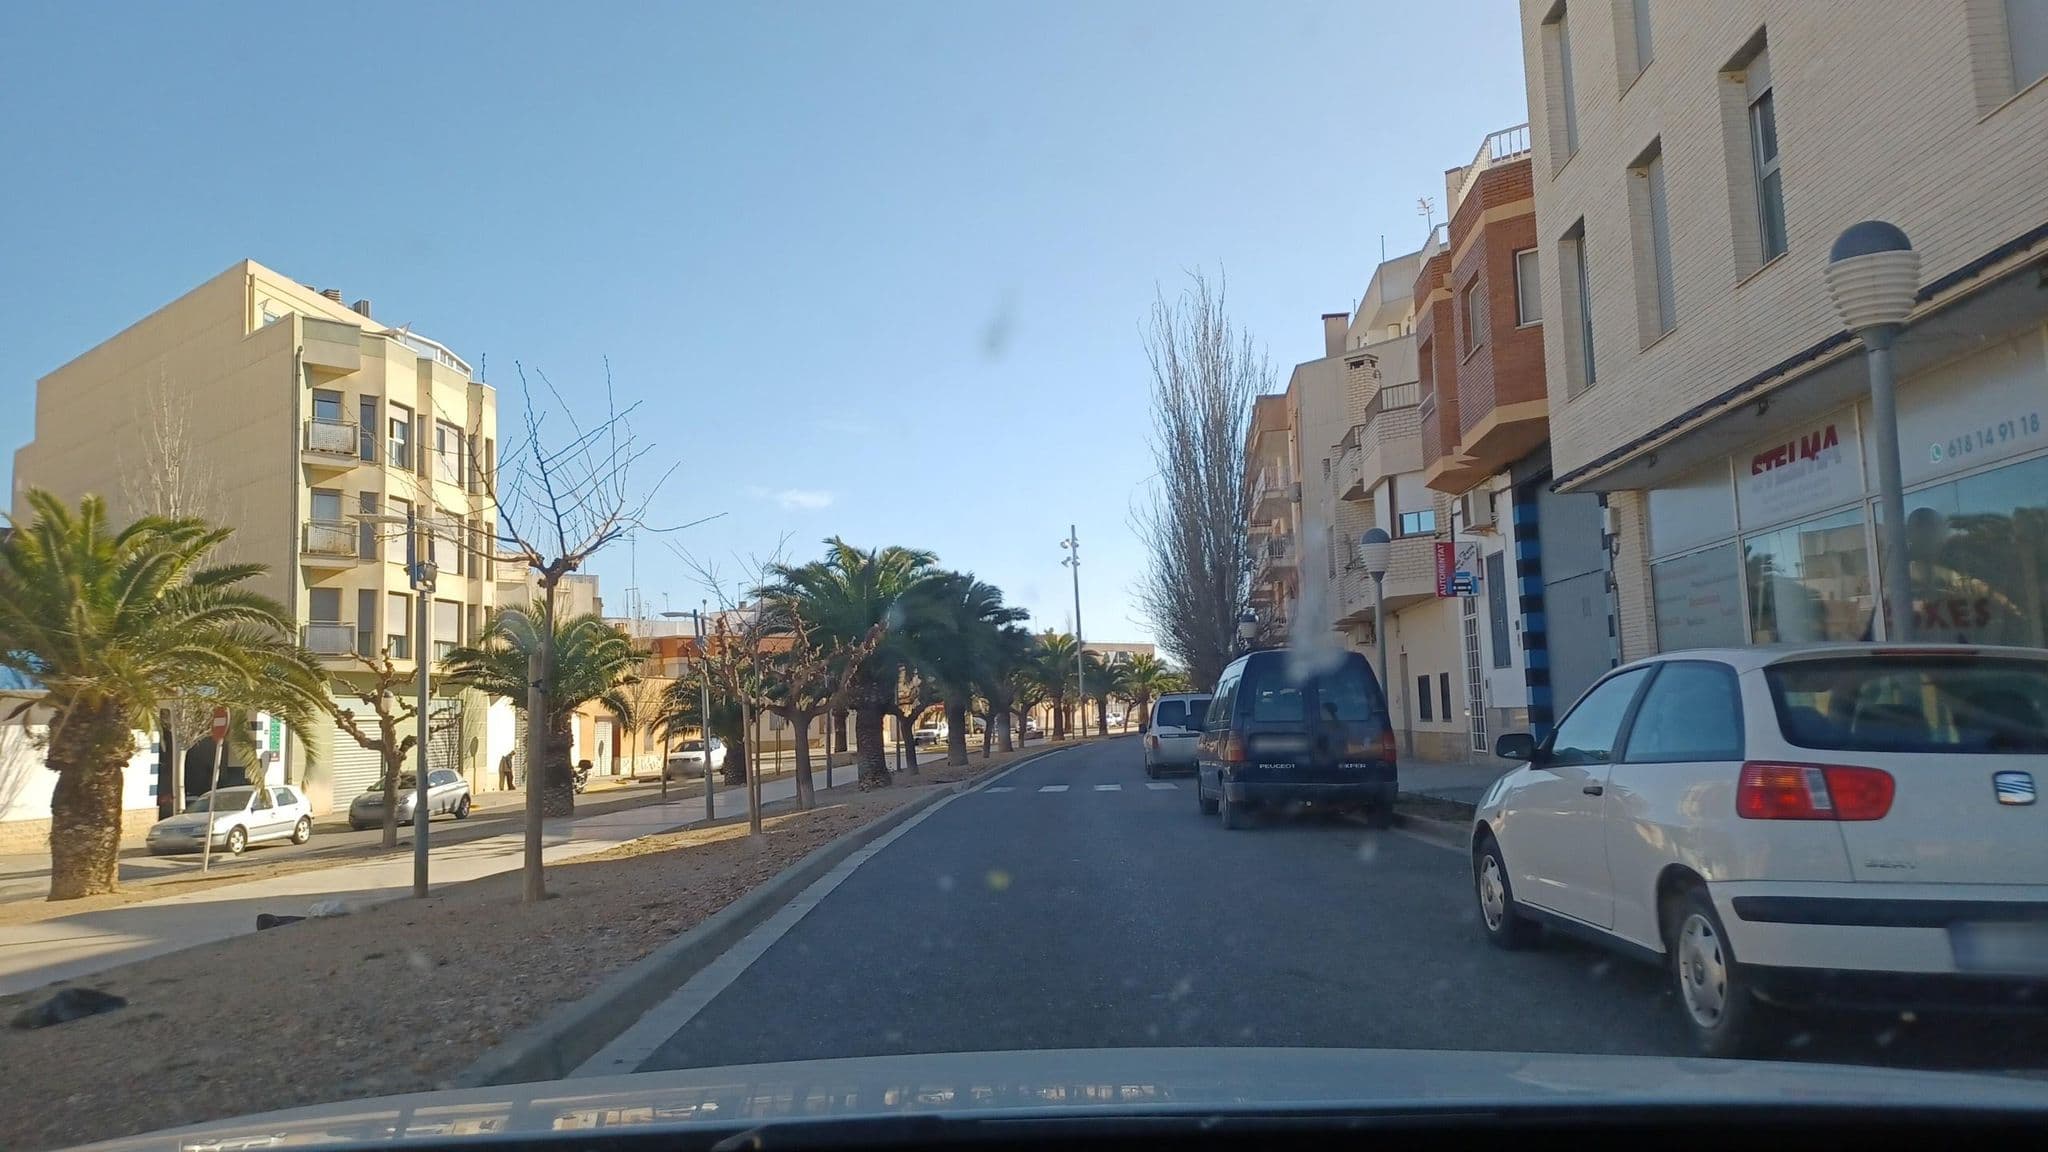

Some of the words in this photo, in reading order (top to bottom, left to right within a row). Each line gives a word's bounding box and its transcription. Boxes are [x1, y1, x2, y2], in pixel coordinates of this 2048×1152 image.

[1948, 433, 1973, 458] 618
[1976, 427, 1994, 448] 14
[1998, 420, 2015, 442] 91
[2020, 412, 2039, 435] 18
